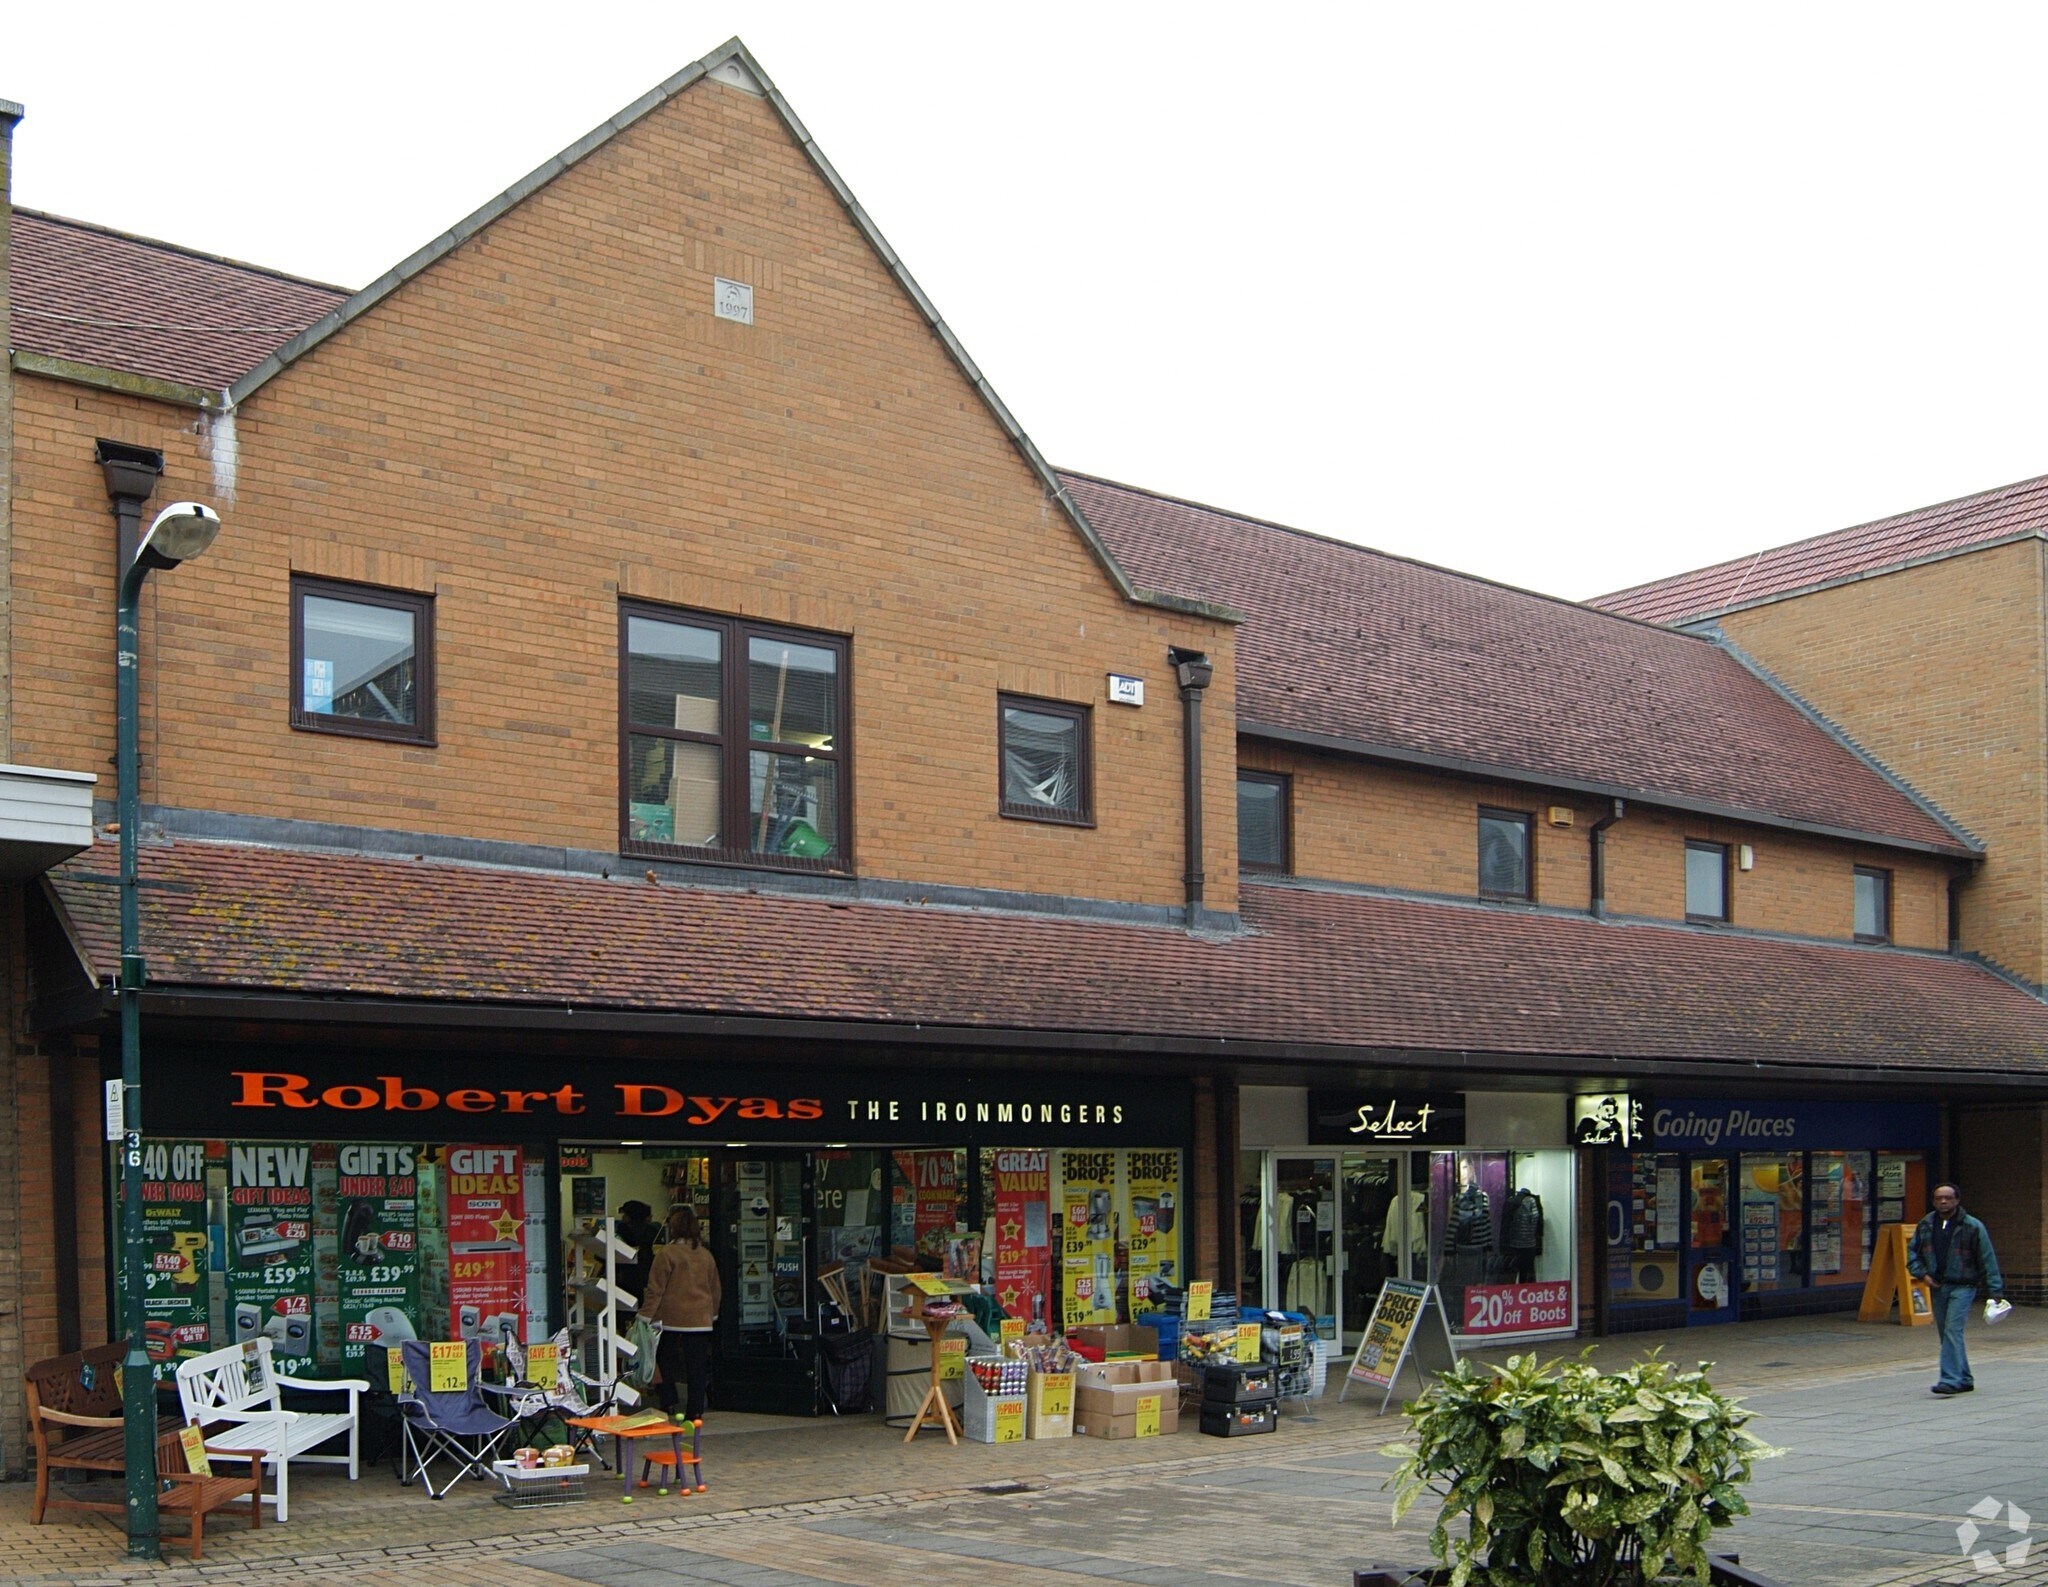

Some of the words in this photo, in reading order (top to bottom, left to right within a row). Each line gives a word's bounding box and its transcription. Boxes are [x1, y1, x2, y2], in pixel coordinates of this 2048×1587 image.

[720, 301, 748, 319] 1997
[1119, 681, 1135, 694] ADT
[231, 1072, 586, 1114] Robert
[614, 1084, 823, 1125] Dyas
[848, 1100, 900, 1120] THE
[921, 1101, 1123, 1124] IRONMONGERS
[1349, 1099, 1436, 1134] Select
[1631, 1099, 1645, 1141] Select
[1653, 1109, 1723, 1145] Going
[1725, 1110, 1796, 1137] Places
[128, 1132, 140, 1148] 3
[1580, 1131, 1618, 1144] Select
[129, 1151, 141, 1166] 6
[172, 1145, 204, 1181] OFF
[339, 1145, 415, 1176] GIFTS
[450, 1149, 517, 1174] GIFT
[997, 1152, 1048, 1172] GREAT
[1067, 1153, 1109, 1167] PRICE
[1131, 1152, 1173, 1167] PRICE
[231, 1147, 309, 1187] NEW
[1067, 1167, 1109, 1183] DROP
[1131, 1166, 1173, 1182] DROP
[340, 1176, 386, 1197] UNDER
[389, 1176, 415, 1197] £40
[450, 1175, 520, 1195] IDEAS
[940, 1172, 955, 1186] OFF
[998, 1172, 1047, 1192] VALUE
[167, 1182, 205, 1202] TOOLS
[232, 1187, 265, 1205] GIFT
[266, 1187, 311, 1205] IDEAS
[286, 1229, 306, 1238] £20
[390, 1233, 412, 1243] £10
[1066, 1240, 1093, 1253] £39.99
[1131, 1237, 1157, 1250] £29.99
[156, 1255, 181, 1265] £140
[999, 1248, 1028, 1265] £19.99
[370, 1264, 414, 1283] £39.99
[453, 1261, 494, 1278] £49.99
[777, 1261, 799, 1272] PUSH
[264, 1266, 310, 1284] £59.99
[1135, 1287, 1149, 1298] £10
[1190, 1284, 1204, 1295] £10
[1518, 1288, 1555, 1305] Coats
[1557, 1285, 1568, 1302] &
[283, 1296, 307, 1309] 1/2
[1382, 1292, 1420, 1313] PRICE
[1066, 1310, 1093, 1324] £19.99
[1377, 1305, 1414, 1328] DROP
[1503, 1309, 1522, 1325] Off
[1529, 1306, 1567, 1323] Boots
[179, 1327, 188, 1335] AS
[188, 1325, 205, 1333] SEEN
[350, 1325, 372, 1335] £15
[1238, 1327, 1252, 1337] £10
[432, 1345, 452, 1358] £17
[529, 1346, 545, 1359] SAVE
[548, 1346, 557, 1358] £5
